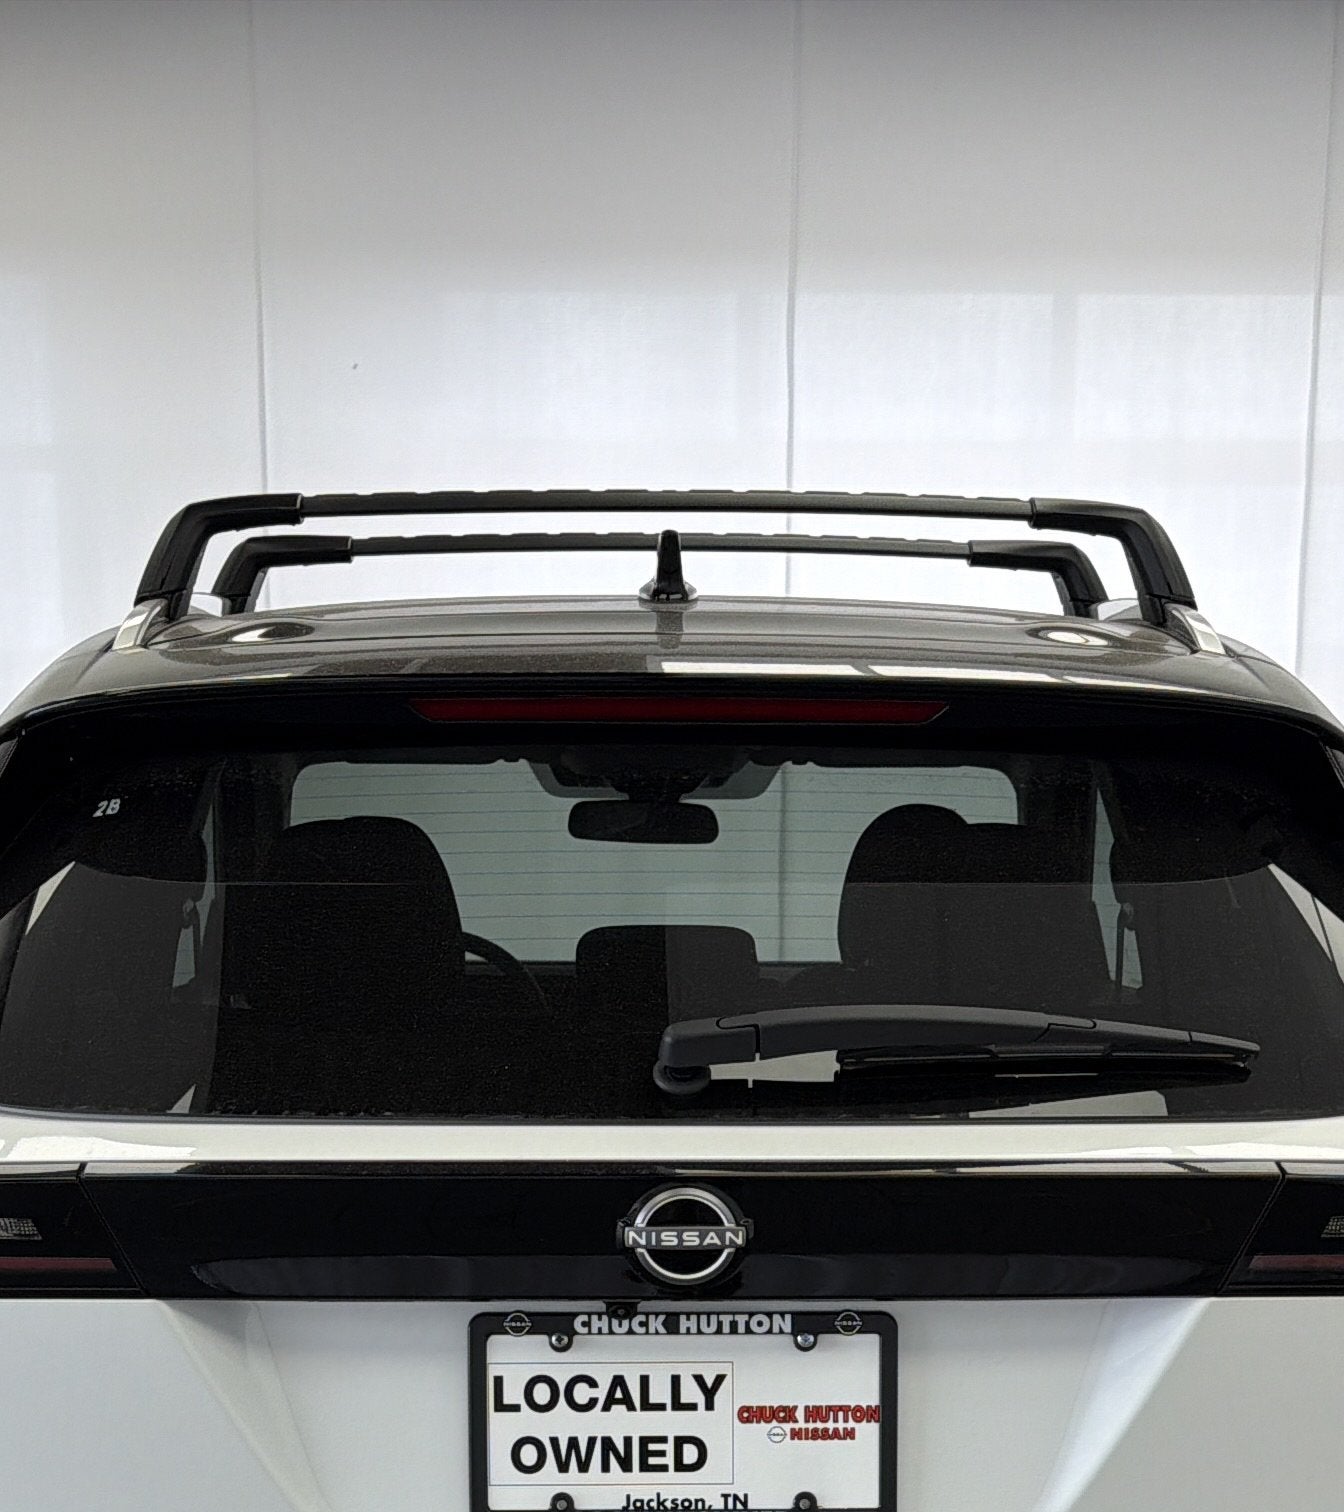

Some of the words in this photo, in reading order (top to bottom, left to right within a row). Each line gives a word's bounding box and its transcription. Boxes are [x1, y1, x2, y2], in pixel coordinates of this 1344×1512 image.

[628, 1231, 743, 1246] NISSAN
[573, 1314, 667, 1334] CHUCK
[679, 1314, 792, 1334] HUTTON
[493, 1374, 728, 1413] LOCALLY
[737, 1405, 799, 1424] CHUCK
[804, 1405, 881, 1424] HUTTON
[790, 1427, 856, 1441] NISSAN
[510, 1435, 708, 1474] OWNED
[721, 1493, 749, 1511] TN
